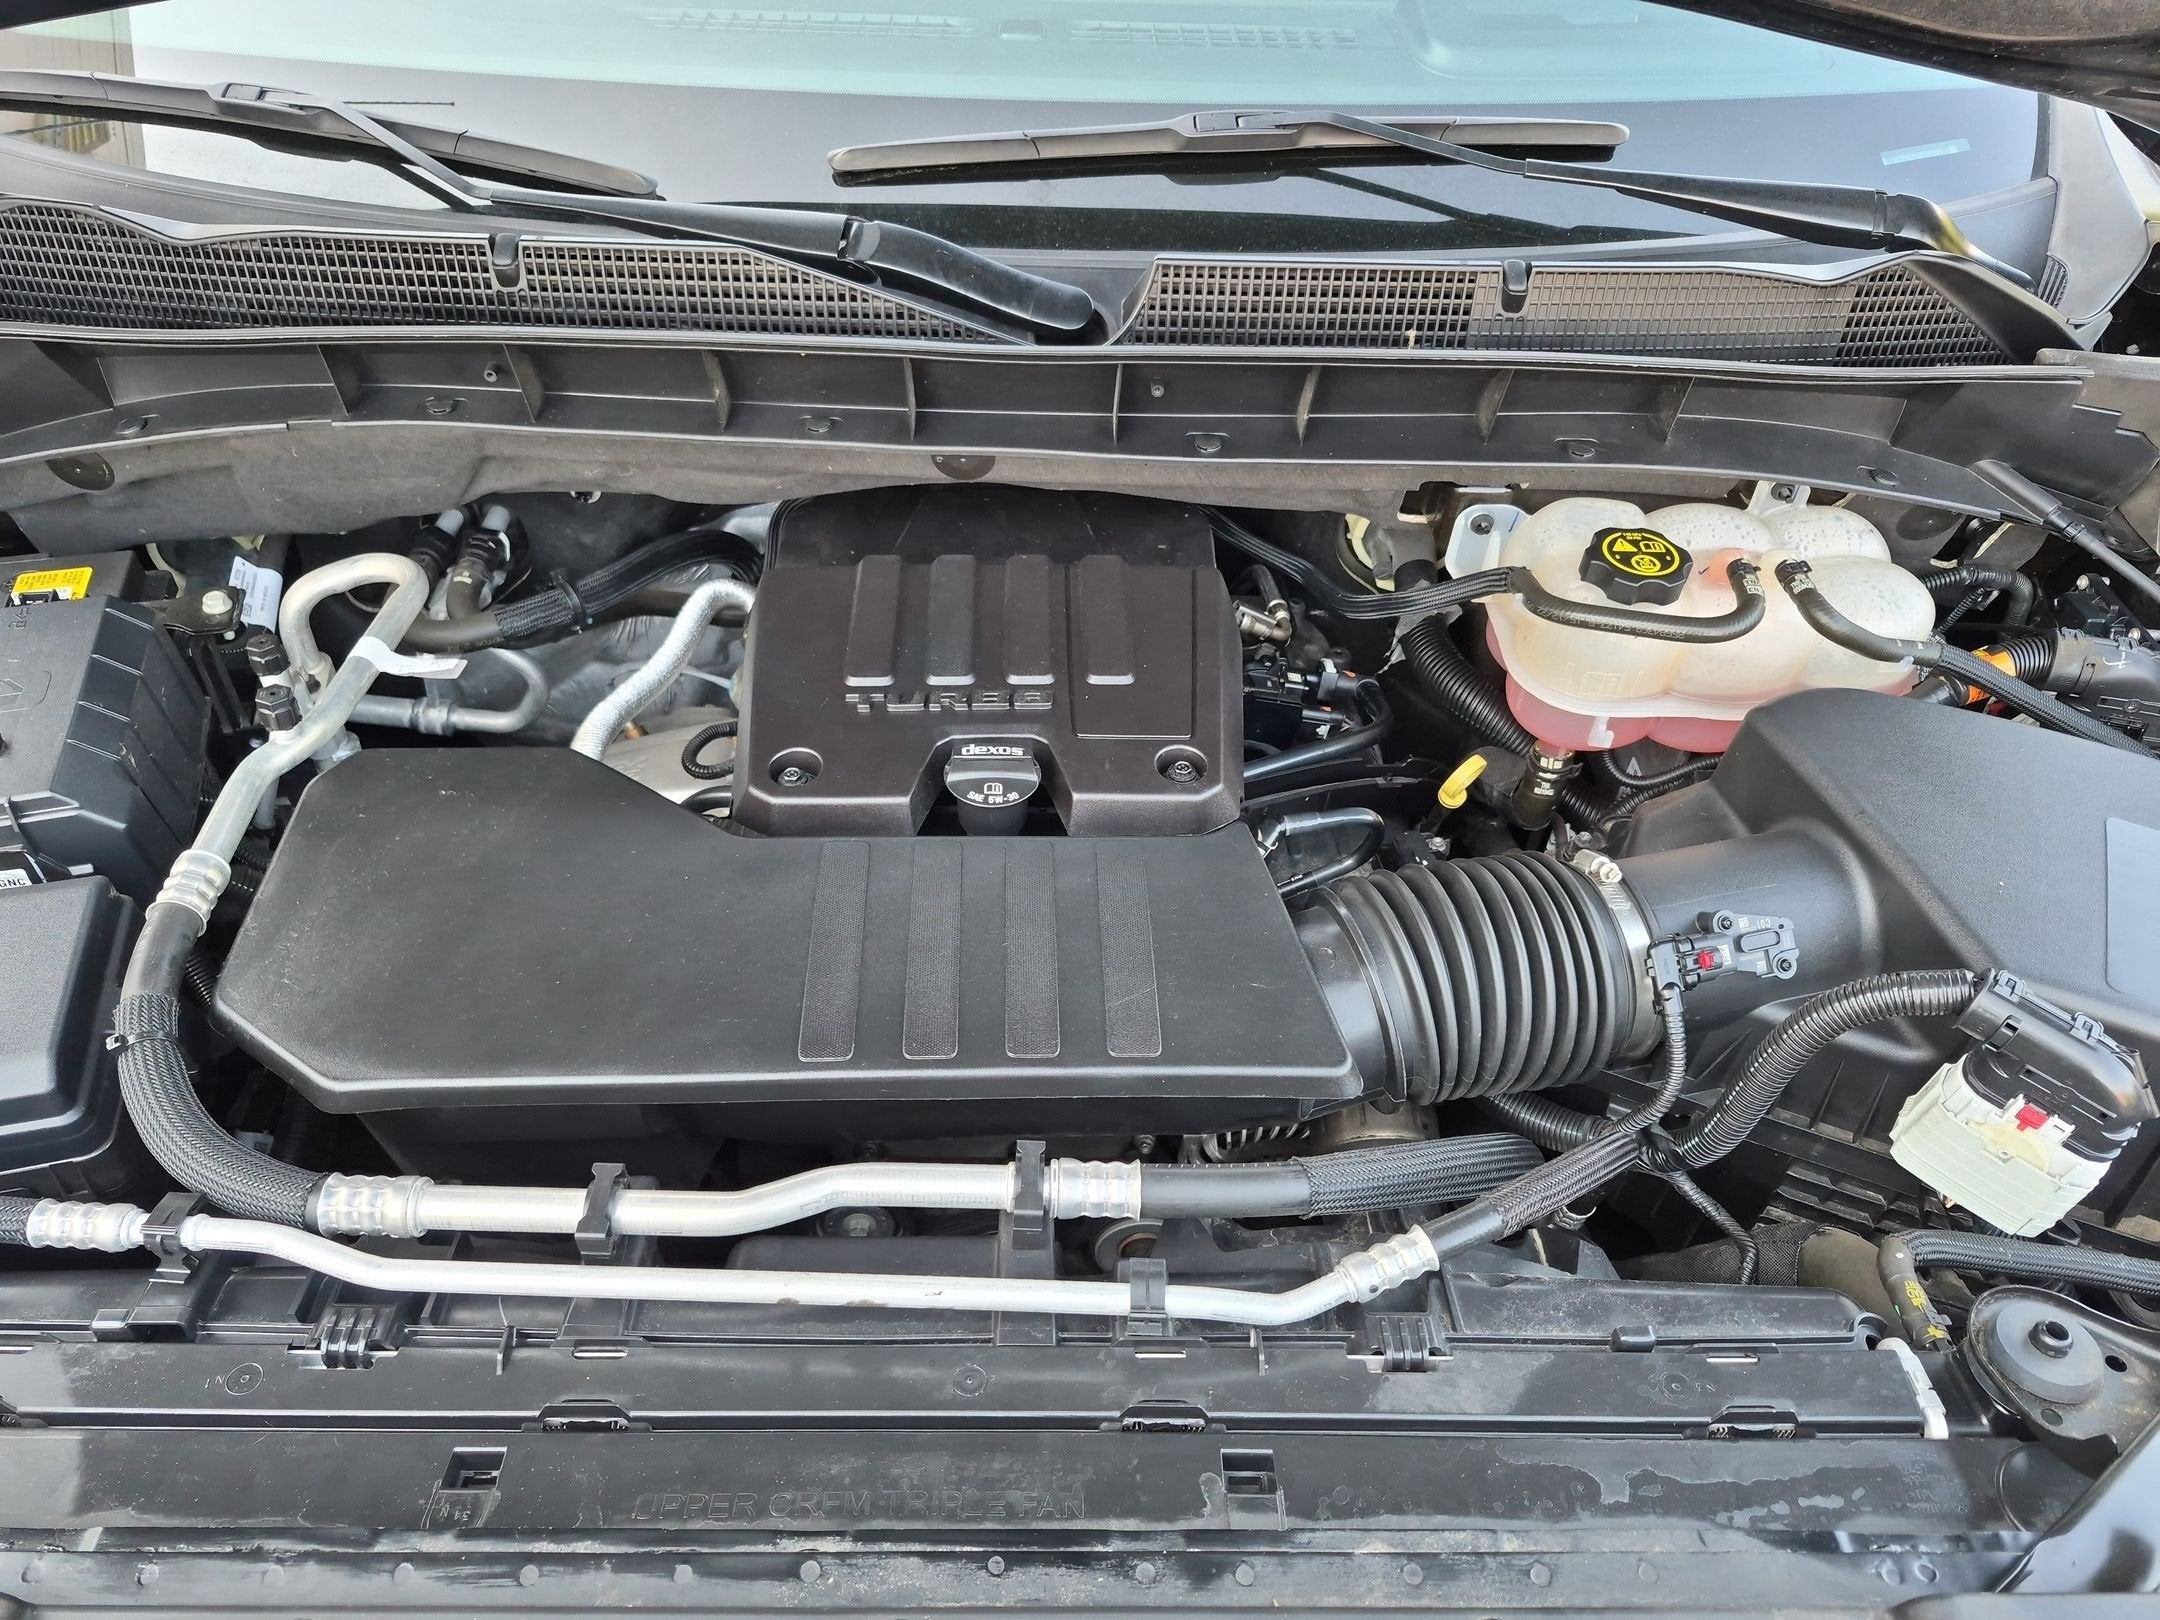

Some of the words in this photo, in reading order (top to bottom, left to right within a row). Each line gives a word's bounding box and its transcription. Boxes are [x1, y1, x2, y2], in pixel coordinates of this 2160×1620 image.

[845, 690, 1053, 712] TURBO
[961, 744, 1025, 756] dexos
[967, 791, 985, 802] SAE
[988, 792, 1019, 803] 5W-30
[633, 1492, 757, 1519] UPPER
[881, 1490, 1006, 1516] TRIPLE
[1018, 1491, 1085, 1518] FAN
